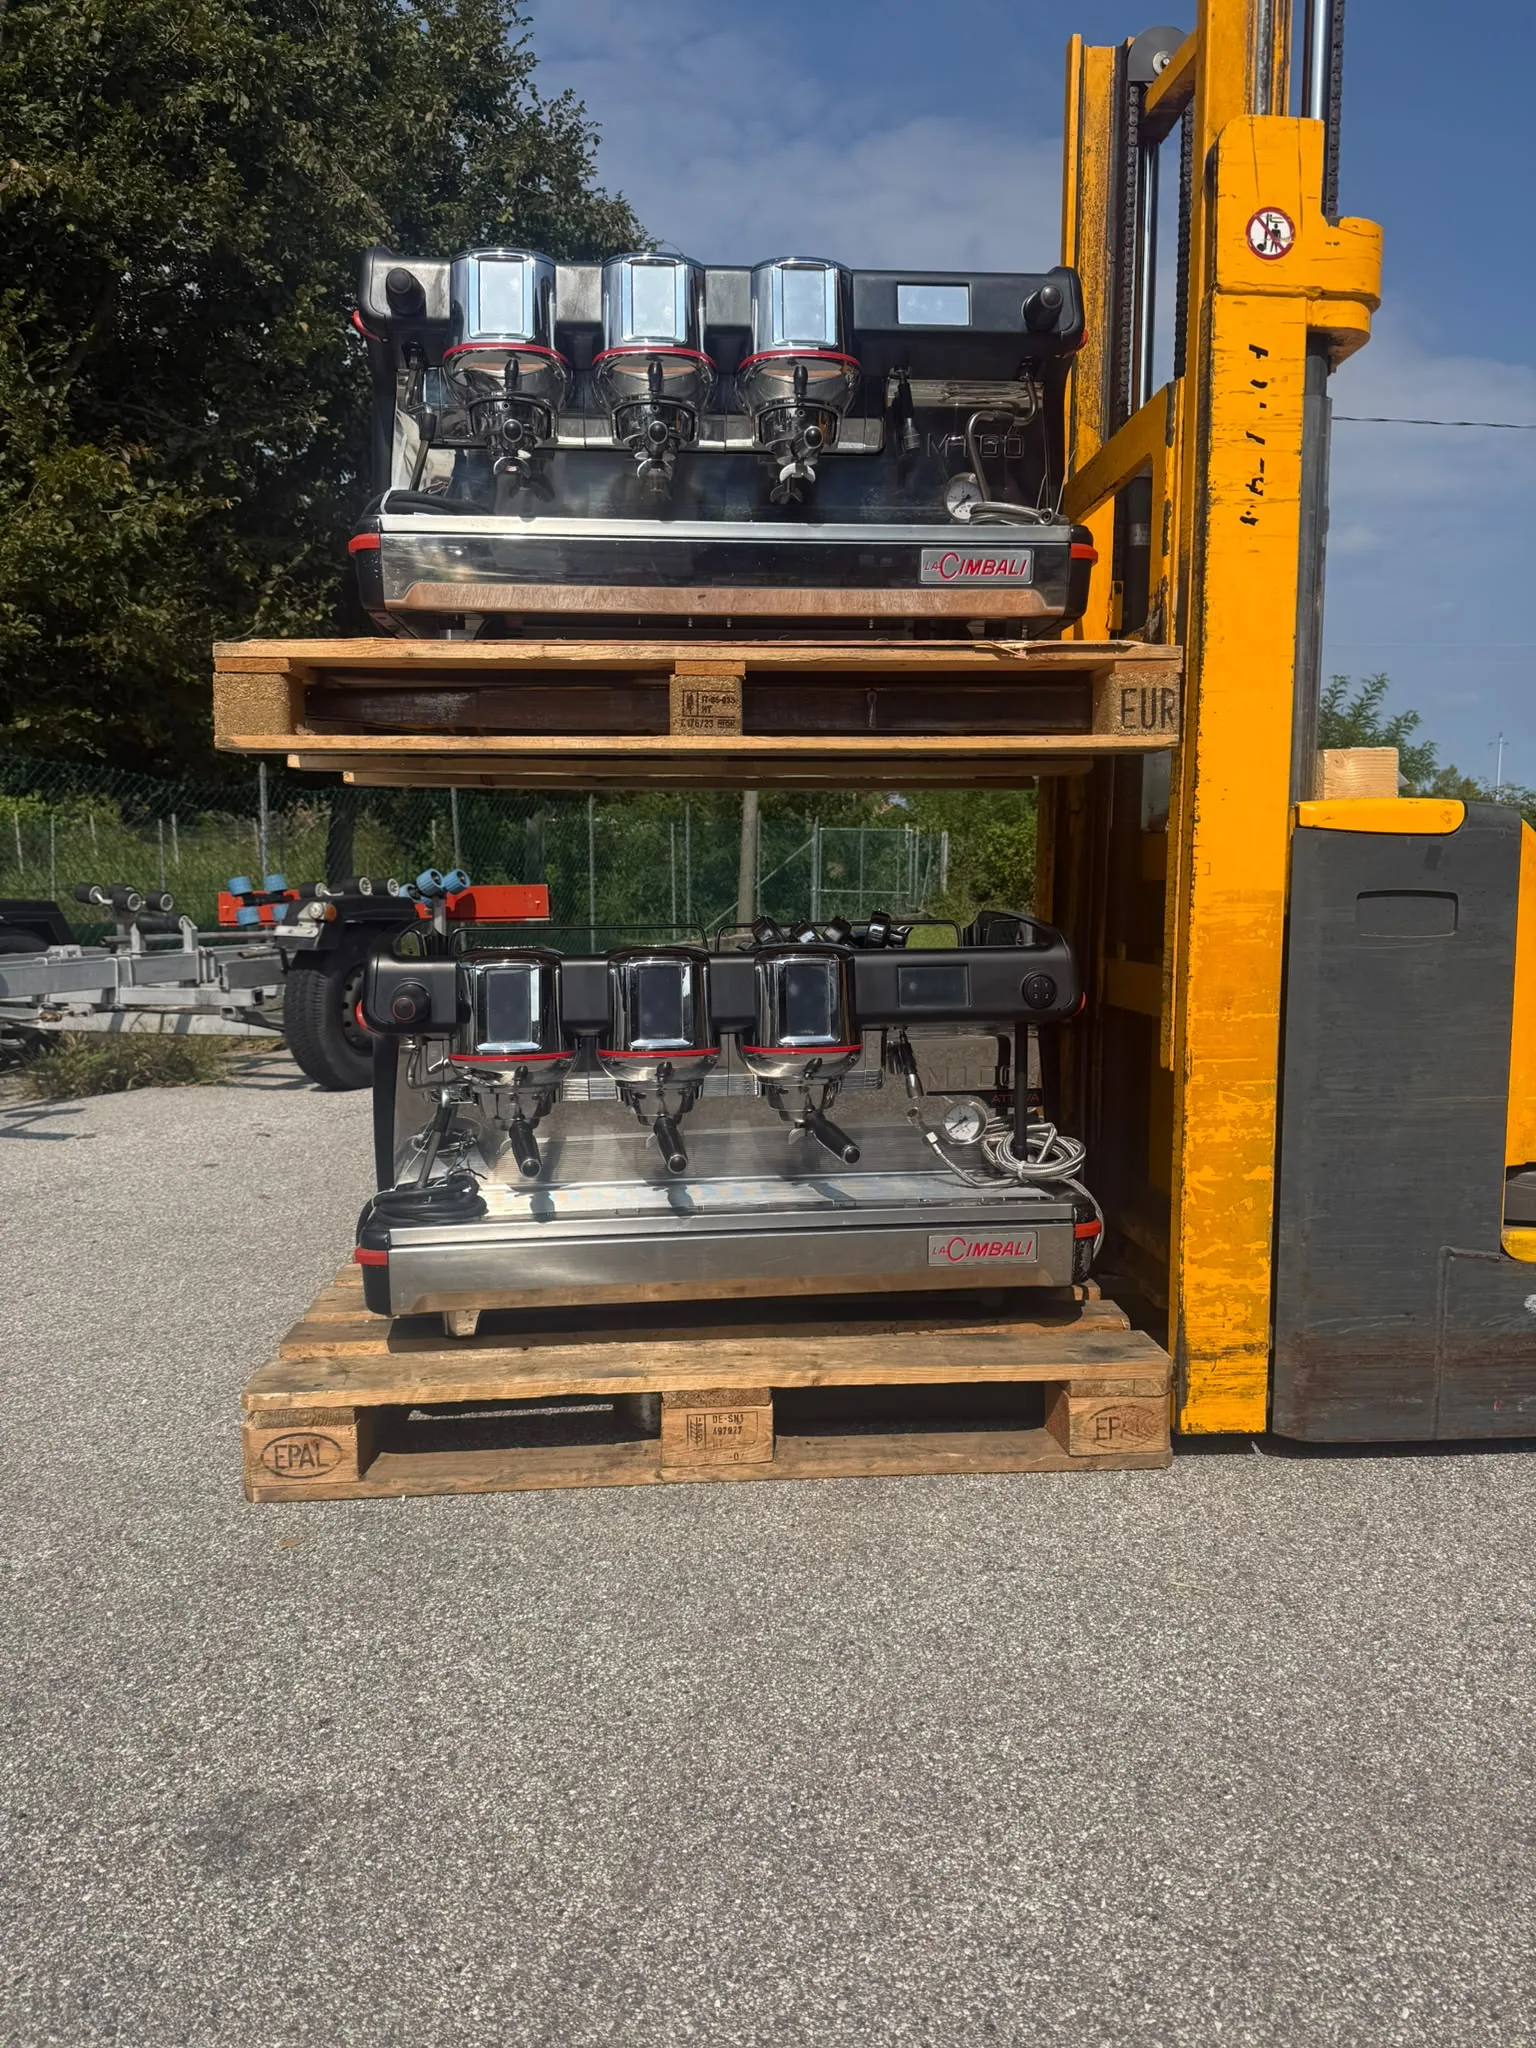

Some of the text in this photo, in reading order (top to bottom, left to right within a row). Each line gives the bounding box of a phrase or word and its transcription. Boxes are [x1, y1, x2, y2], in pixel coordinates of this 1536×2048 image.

[924, 552, 1028, 580] LA CIMBALI
[1121, 687, 1176, 729] EUR
[932, 1237, 1033, 1263] LA CIMBALI
[274, 1441, 330, 1469] EPAL
